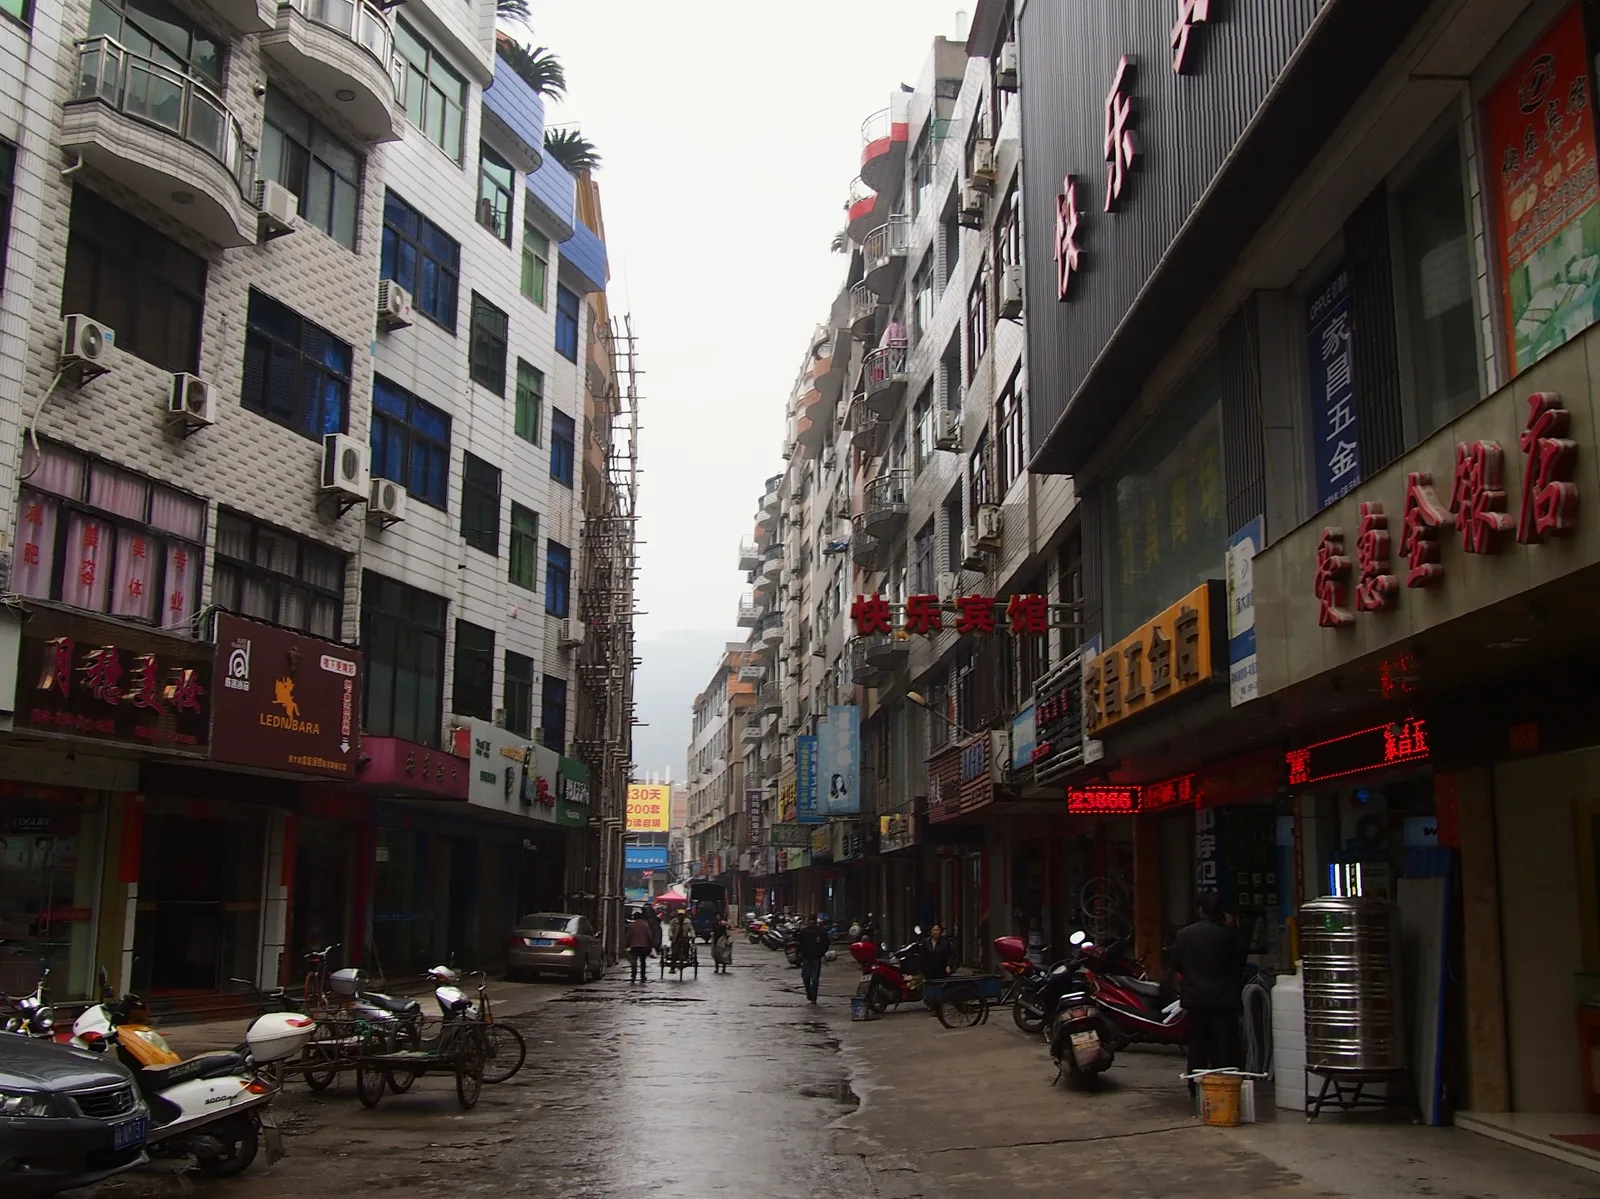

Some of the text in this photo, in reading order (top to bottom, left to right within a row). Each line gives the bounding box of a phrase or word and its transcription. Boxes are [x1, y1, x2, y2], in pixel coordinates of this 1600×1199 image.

[1321, 310, 1357, 485] 家昌五金
[81, 523, 99, 587] 美容
[850, 592, 1049, 636] 快乐宾馆
[627, 787, 661, 800] 30天
